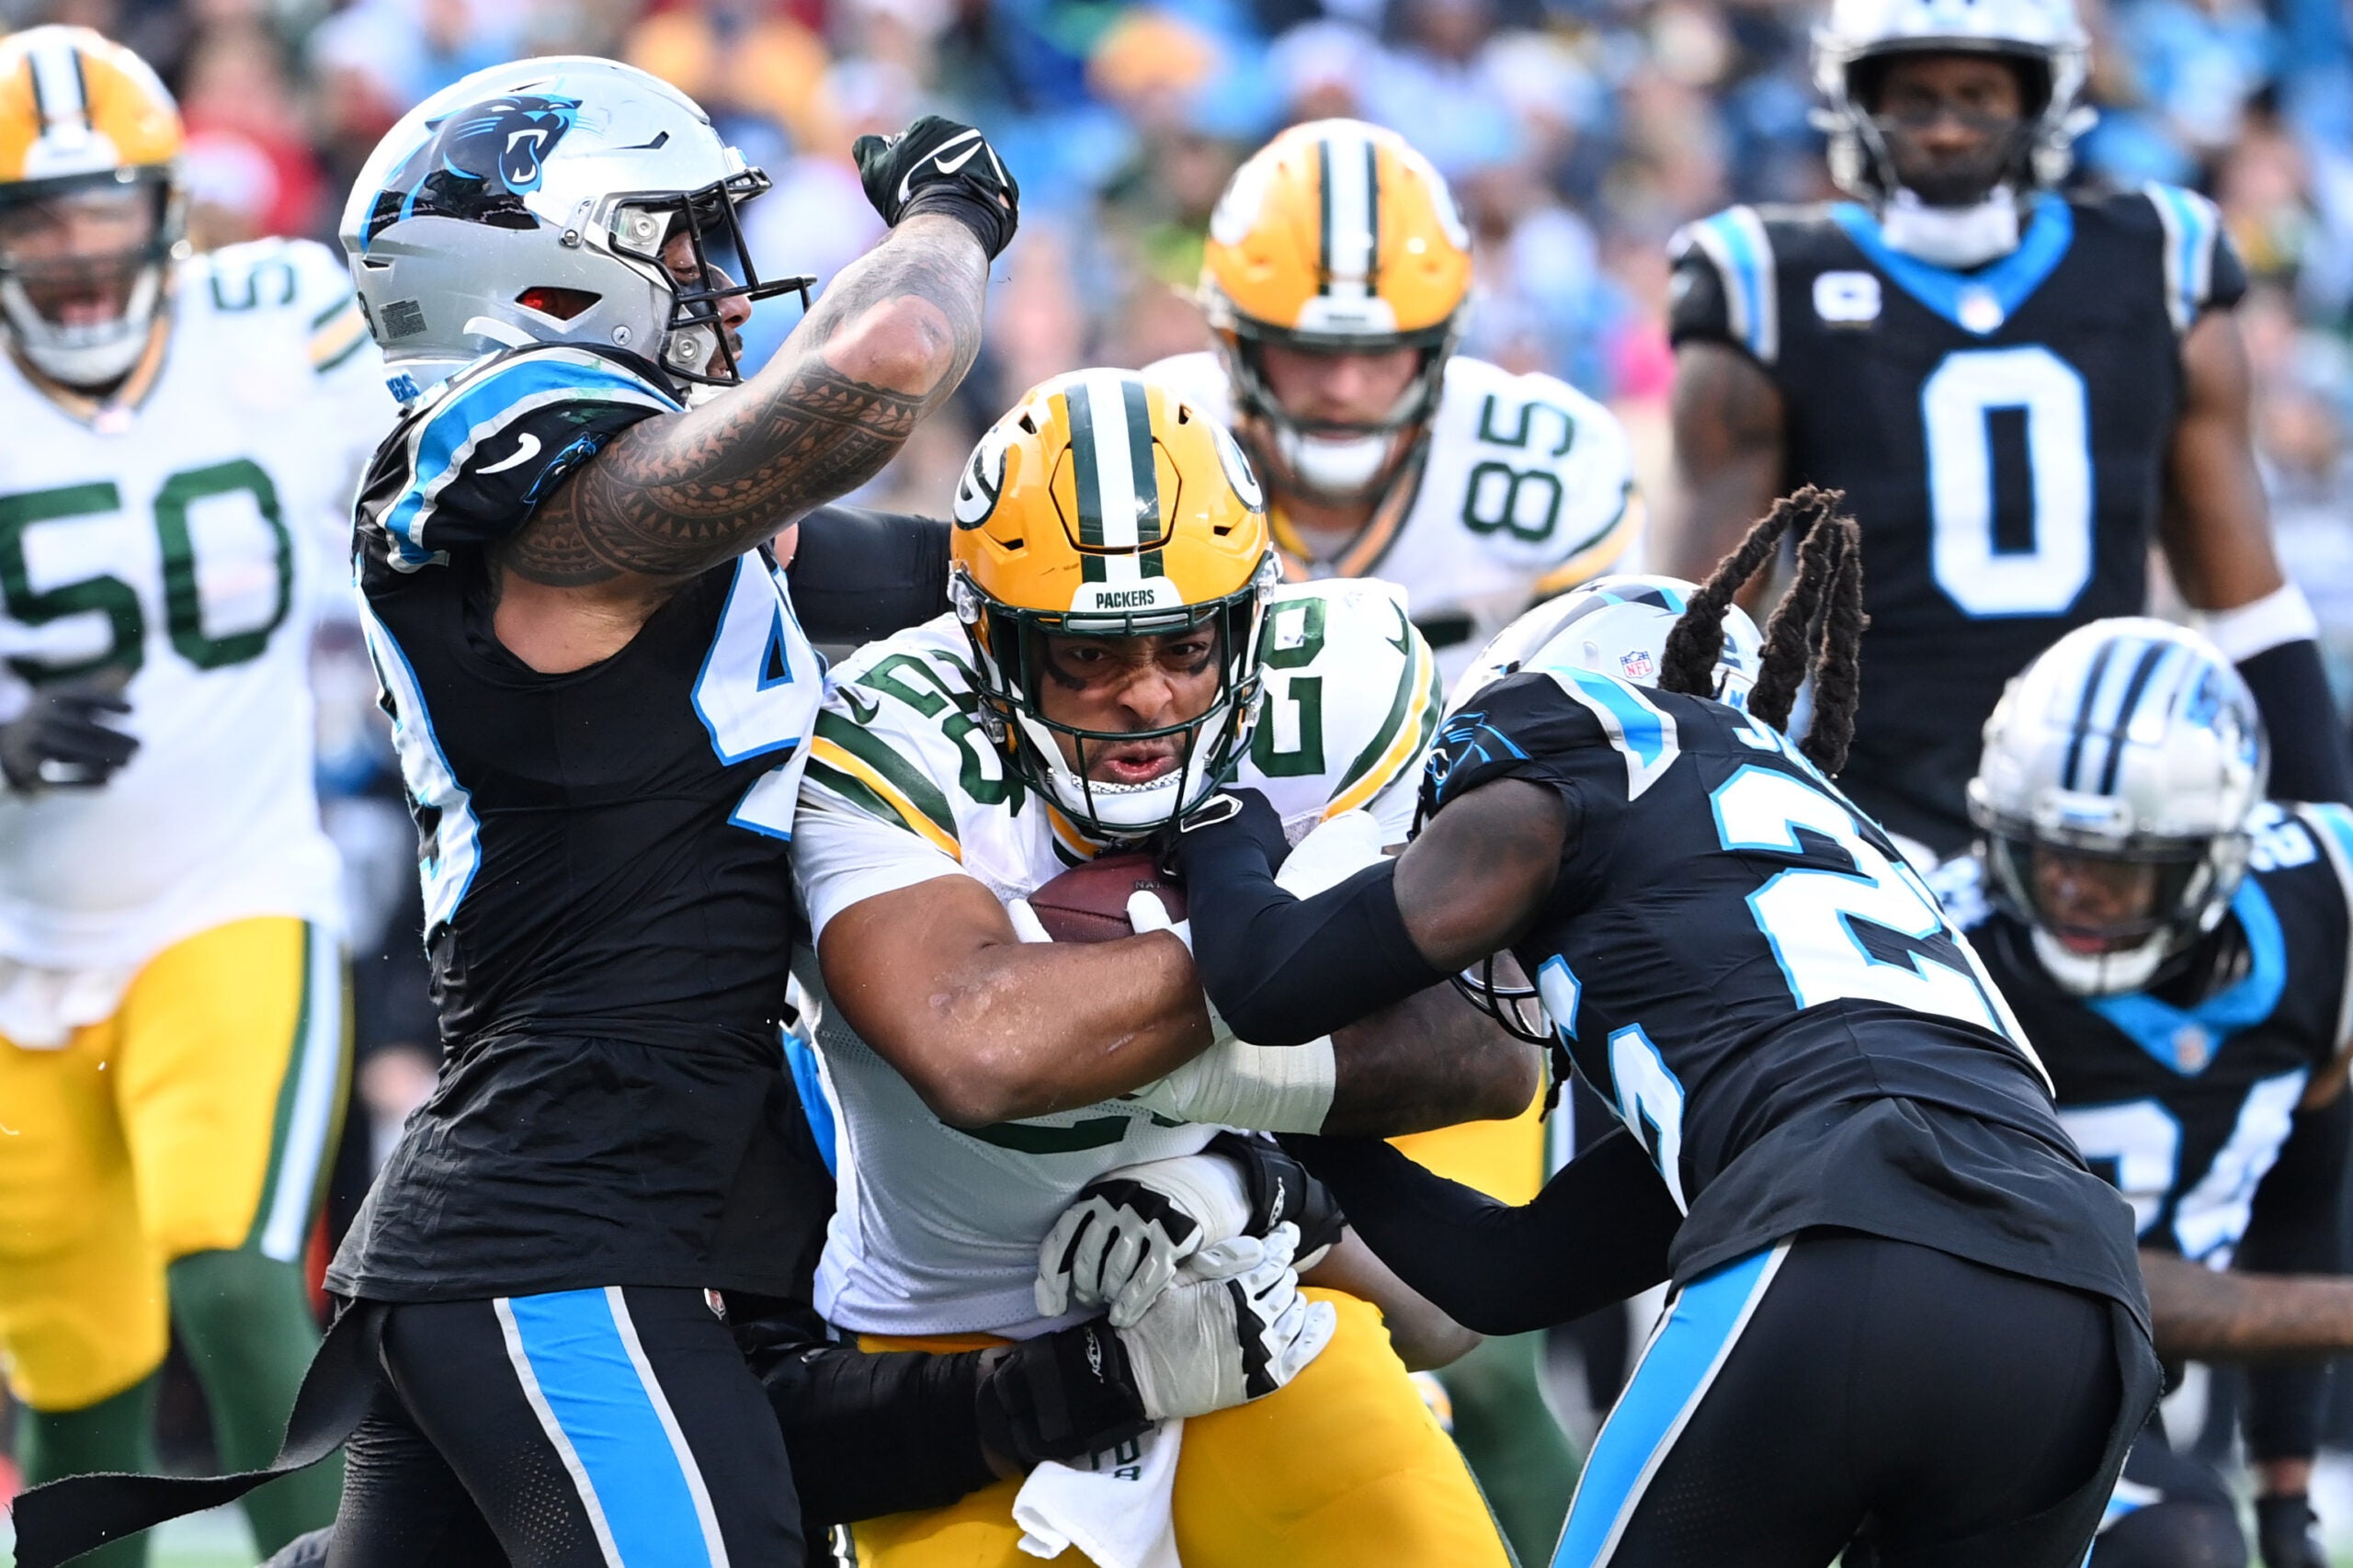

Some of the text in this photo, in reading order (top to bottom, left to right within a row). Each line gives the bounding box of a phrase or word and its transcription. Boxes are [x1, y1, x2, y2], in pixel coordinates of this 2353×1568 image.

[1461, 393, 1575, 543] 85
[1921, 343, 2095, 619] 0
[0, 459, 294, 681] 50
[1096, 589, 1155, 608] PACKERS
[1626, 661, 1651, 676] NFL
